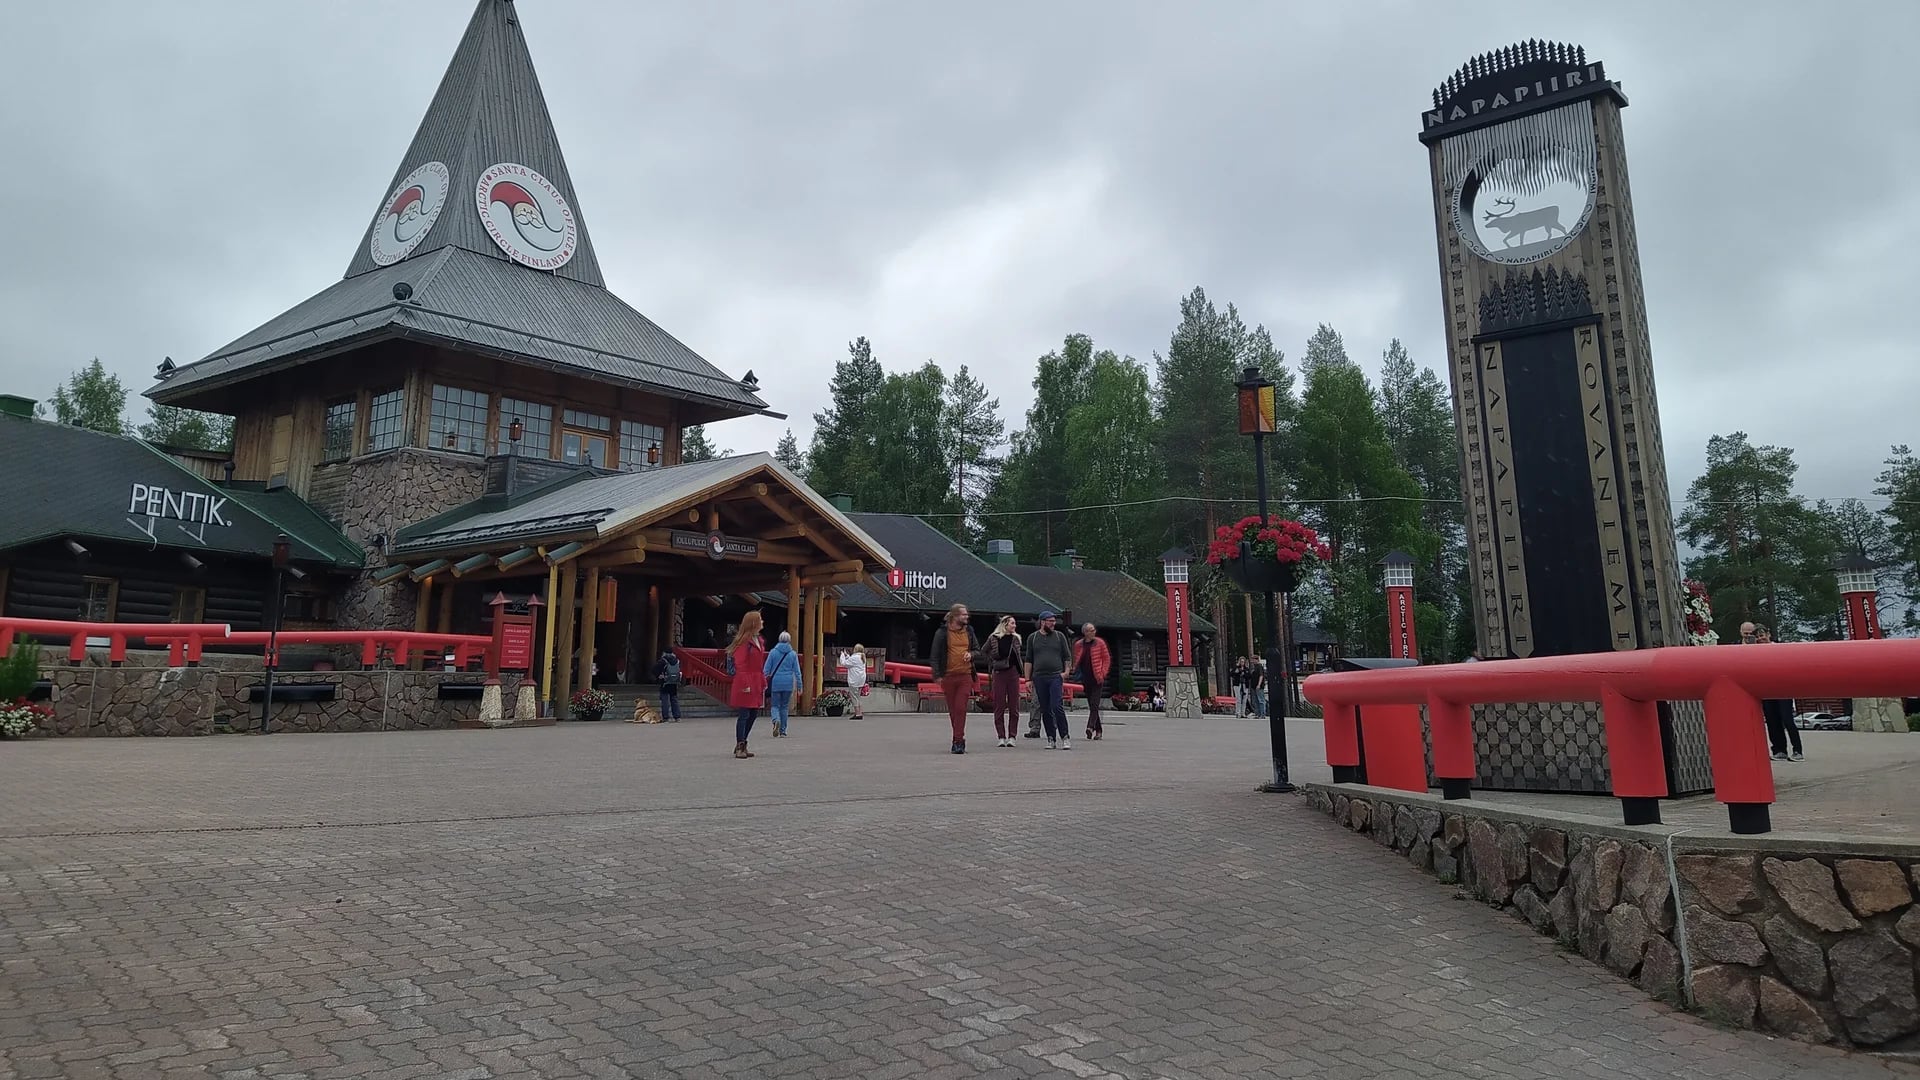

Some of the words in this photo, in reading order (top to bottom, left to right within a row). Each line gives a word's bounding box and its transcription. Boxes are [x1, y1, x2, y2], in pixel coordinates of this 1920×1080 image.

[1428, 66, 1598, 128] NAPAPIIRI
[429, 163, 448, 182] CLAUS
[479, 177, 490, 219] ARCTIC
[486, 220, 520, 258] CIRCLE
[520, 253, 566, 268] FINLAND
[490, 165, 527, 178] SANTA
[530, 173, 564, 205] CLAUS
[562, 209, 575, 252] OFFICE
[1506, 249, 1553, 264] NAPAPIIRI
[1485, 346, 1528, 644] NAPAPIIRI
[1579, 329, 1630, 643] ROVANIEMI
[905, 570, 947, 589] iittala
[1174, 589, 1182, 624] ARCTIC
[1399, 593, 1407, 629] ARCTIC
[1863, 598, 1874, 633] ARCTIC
[1176, 627, 1184, 662] CIRCLE
